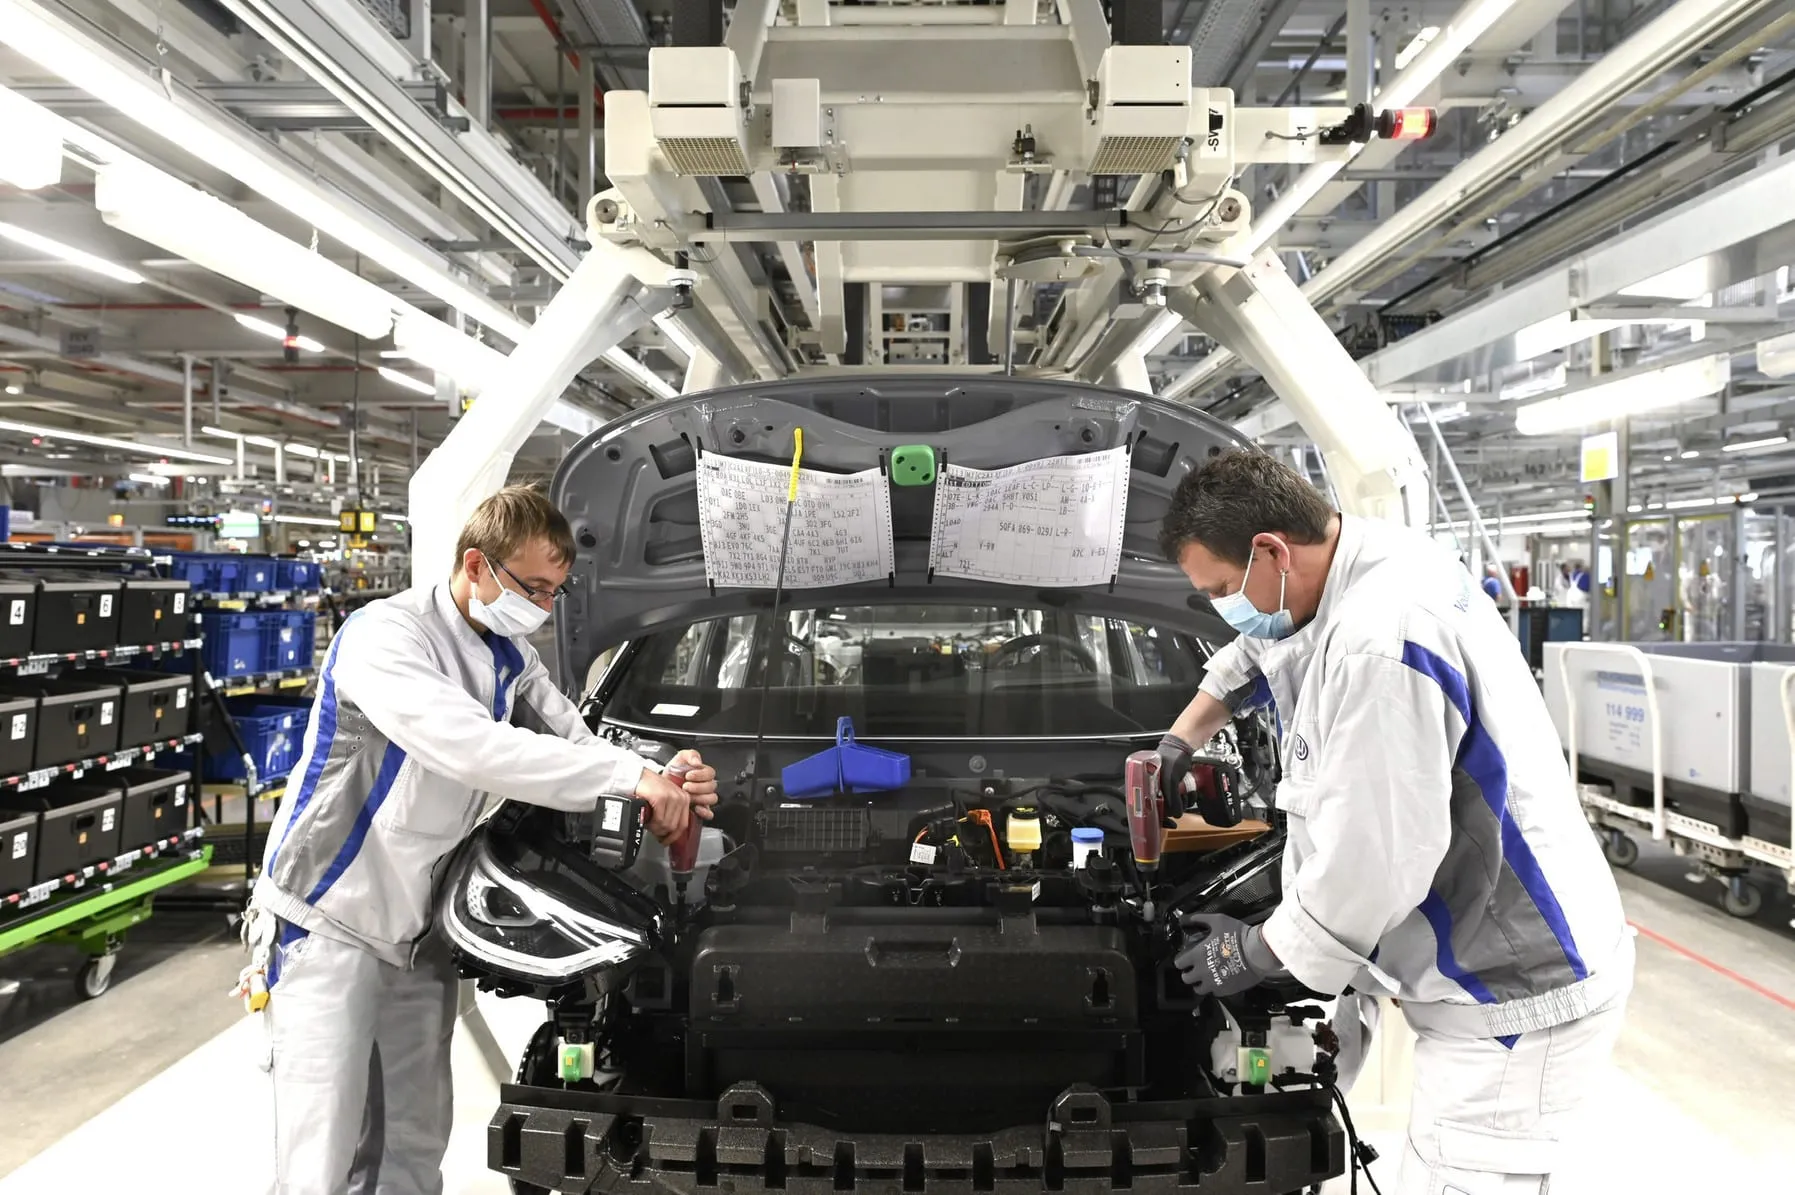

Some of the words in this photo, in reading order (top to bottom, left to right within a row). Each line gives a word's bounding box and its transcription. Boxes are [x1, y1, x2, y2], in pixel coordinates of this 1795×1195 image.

[13, 605, 22, 619] 4
[102, 599, 110, 613] 6
[14, 720, 26, 732] 12
